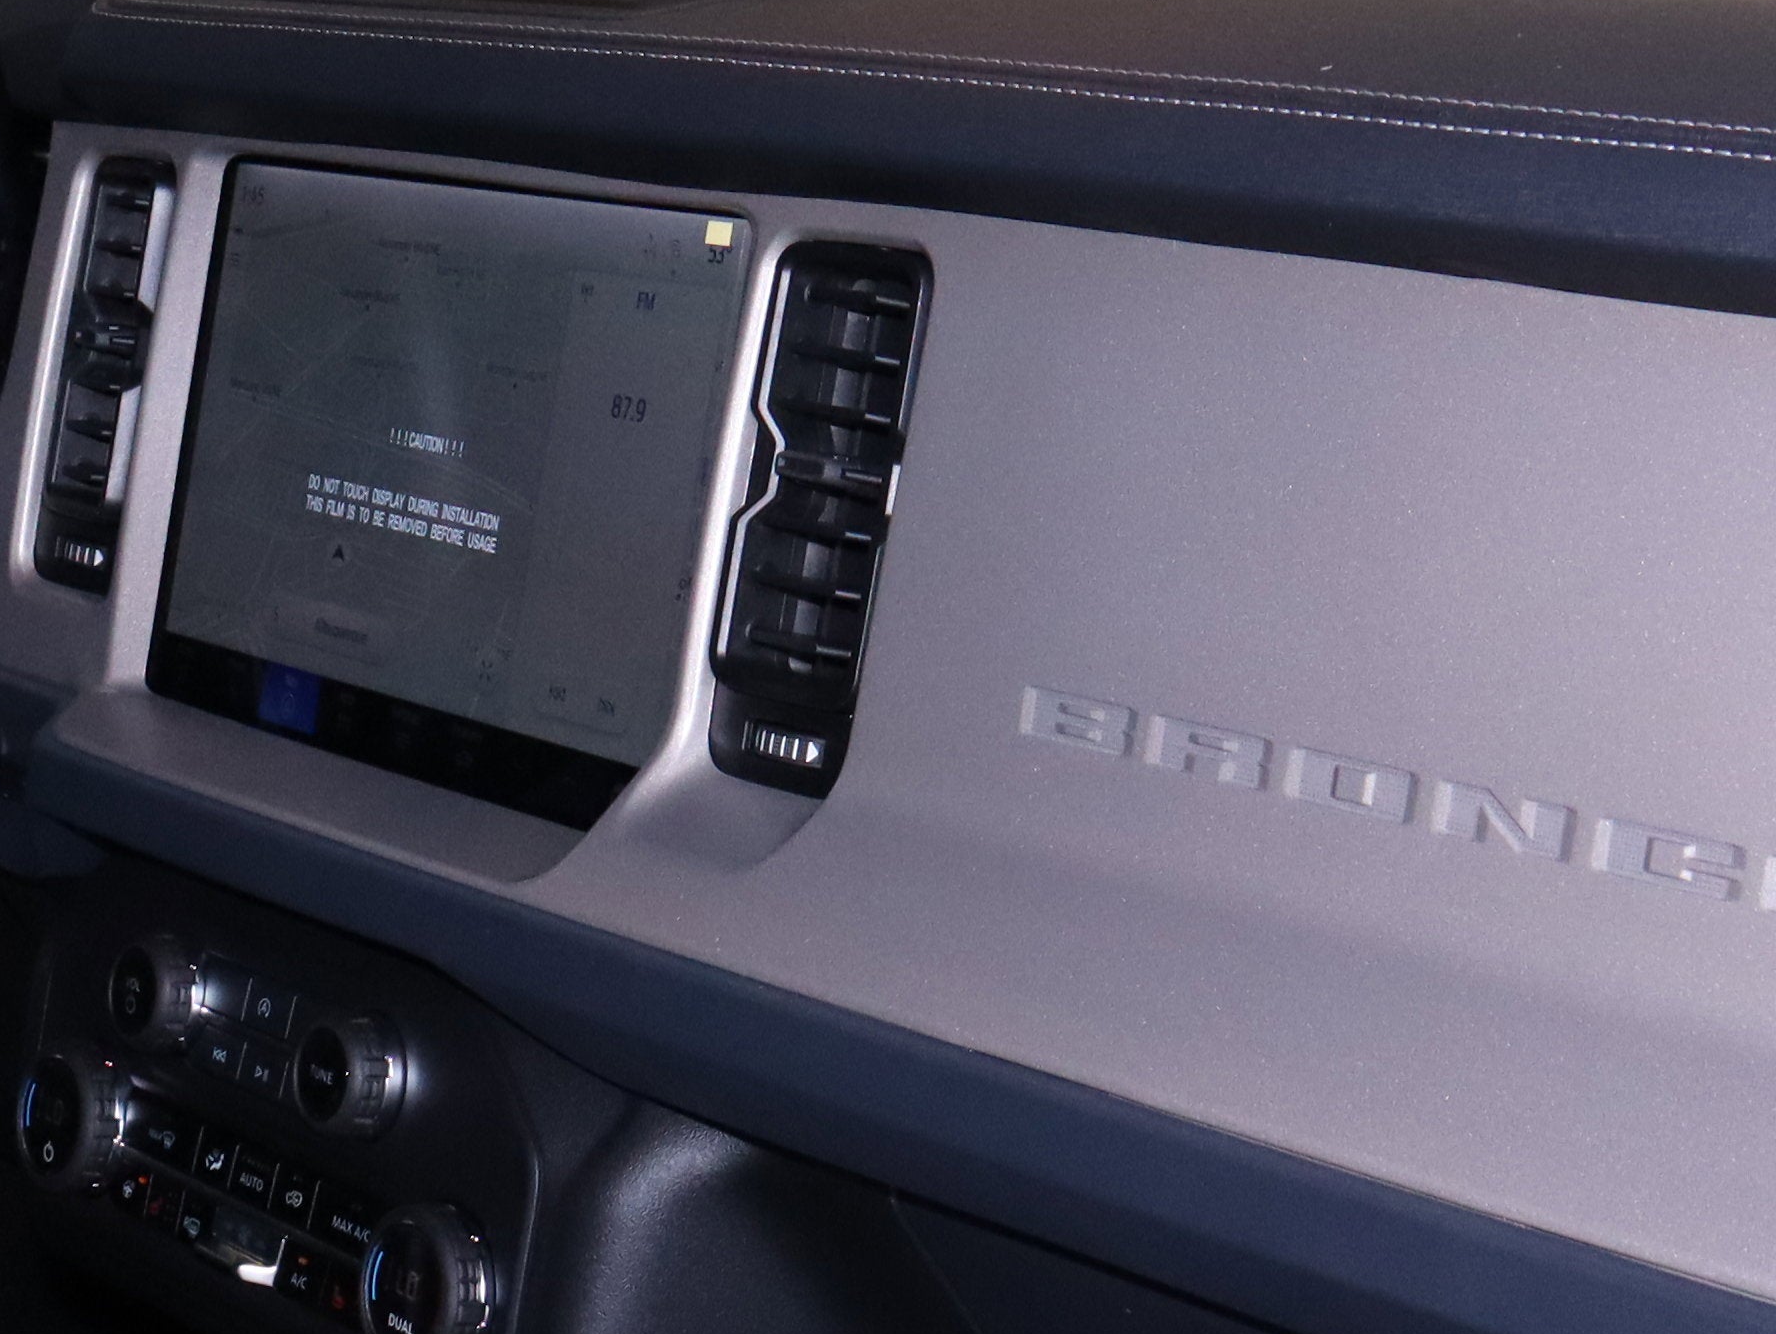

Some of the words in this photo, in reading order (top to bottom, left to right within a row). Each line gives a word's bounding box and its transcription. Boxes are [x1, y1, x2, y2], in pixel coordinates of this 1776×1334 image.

[635, 290, 657, 313] FM
[610, 393, 648, 425] 87.9
[308, 473, 321, 490] DO
[323, 477, 341, 495] NOT
[343, 481, 369, 502] TOUCH
[371, 487, 406, 509] DISPLAY
[408, 495, 439, 518] DURING
[441, 502, 501, 532] INSTALLATION
[305, 493, 323, 513] THIS
[325, 499, 345, 518] FILM
[346, 503, 356, 520] IS
[359, 507, 371, 524] TO
[372, 510, 385, 527] BE
[387, 513, 428, 538] REMOVED
[430, 522, 466, 547] BEFORE
[467, 530, 498, 554] USAGE
[310, 1063, 335, 1086] TUNE
[239, 1172, 265, 1192] AUTO
[330, 1215, 354, 1235] MAX
[354, 1225, 372, 1244] A/C
[290, 1272, 309, 1290] A/C
